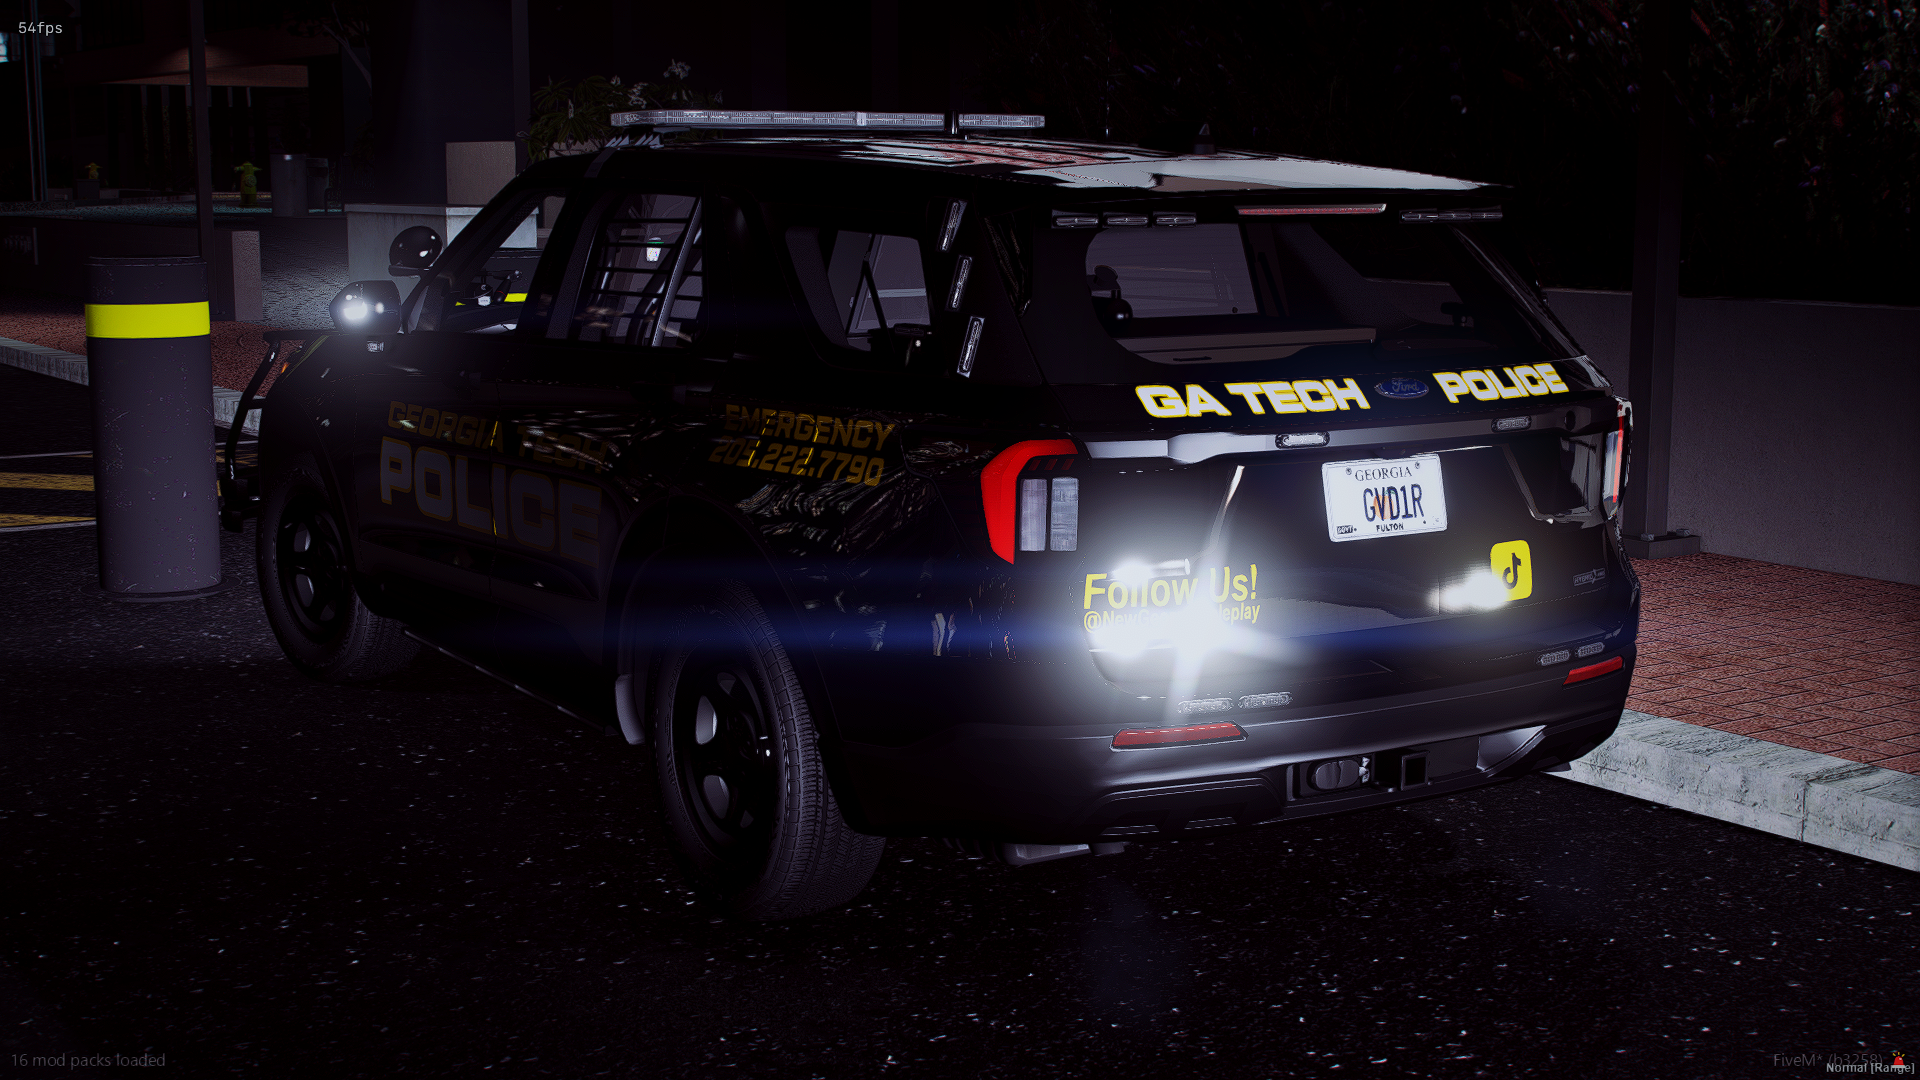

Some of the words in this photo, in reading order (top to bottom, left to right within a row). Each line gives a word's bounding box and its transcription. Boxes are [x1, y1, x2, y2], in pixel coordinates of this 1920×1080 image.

[1135, 384, 1233, 419] GA
[1224, 378, 1372, 415] TECH
[1432, 363, 1570, 403] POLICE
[388, 401, 505, 454] GEORGIA
[723, 403, 896, 452] EMERGENCY
[708, 435, 886, 488] 205.222.7790
[1355, 466, 1413, 482] GEORGIA
[380, 436, 603, 569] POLICE
[1362, 483, 1425, 523] GVD1R
[1375, 523, 1405, 533] FULTON
[1083, 573, 1199, 610] Follow
[1209, 563, 1258, 604] Us!
